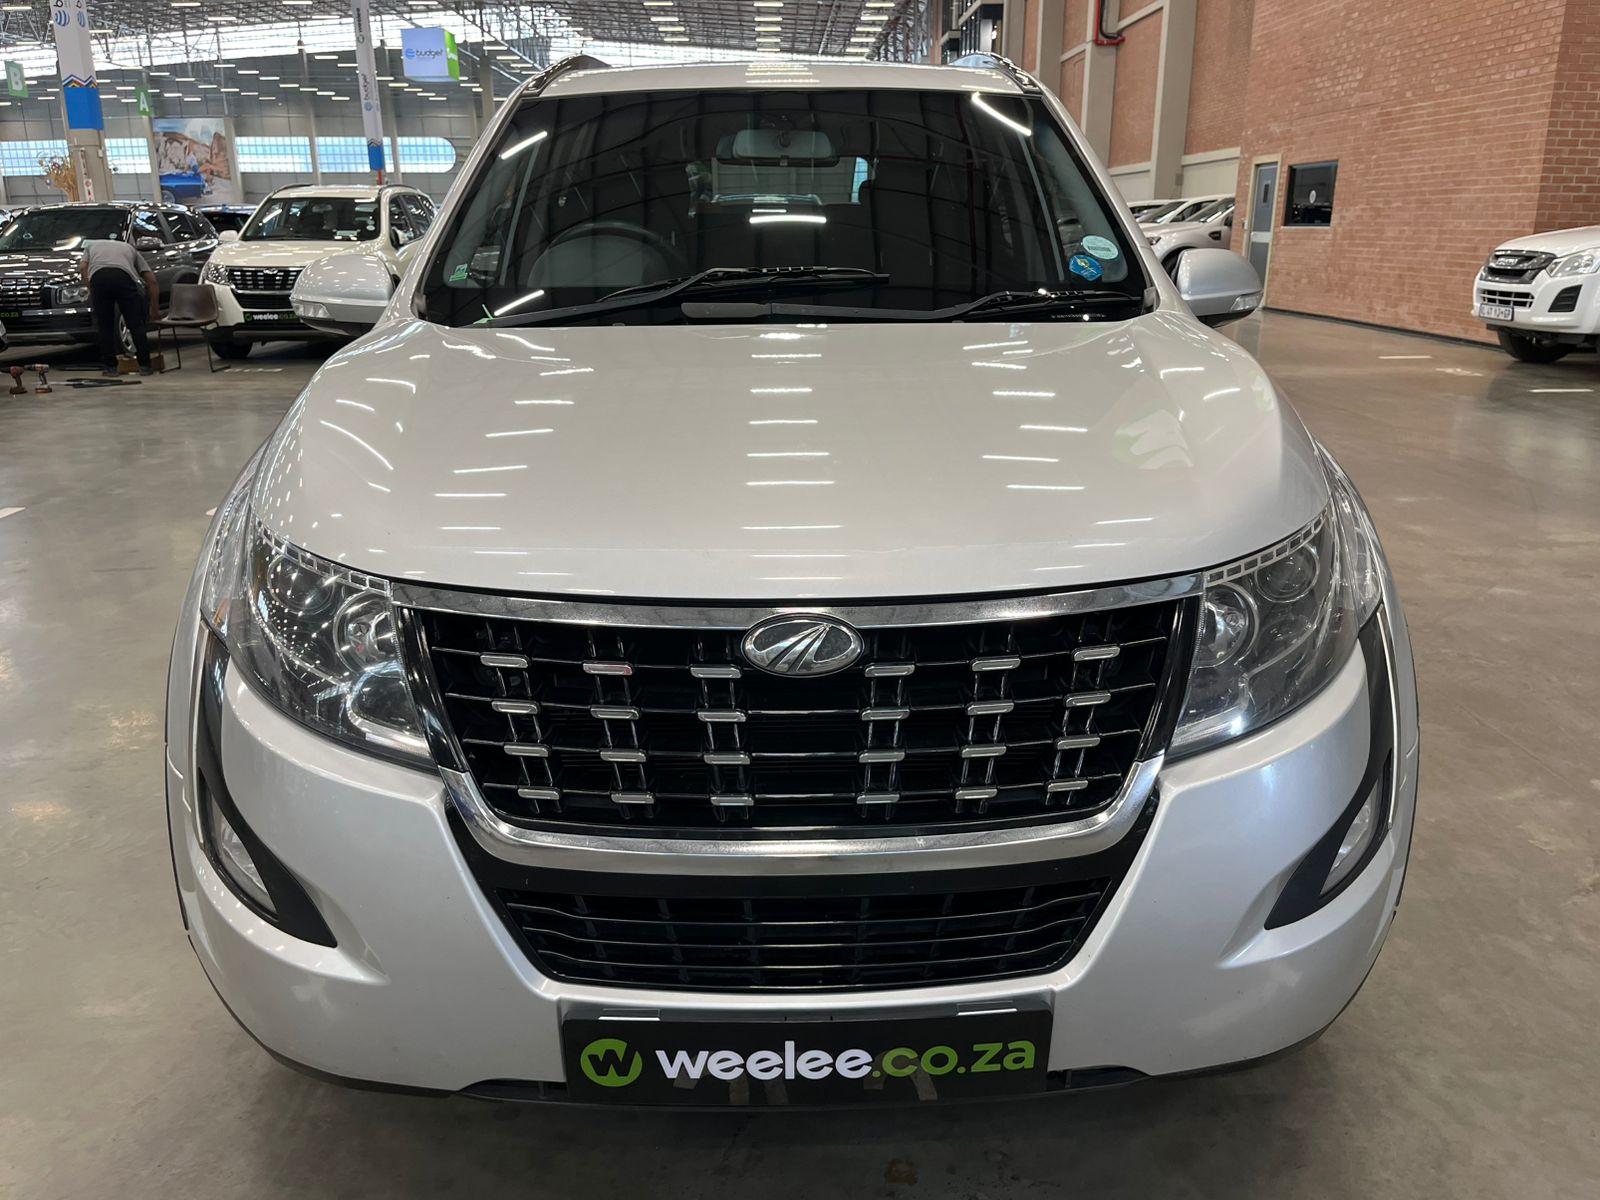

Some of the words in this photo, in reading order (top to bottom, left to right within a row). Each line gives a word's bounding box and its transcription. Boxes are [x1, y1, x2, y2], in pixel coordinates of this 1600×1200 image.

[10, 67, 23, 91] B
[140, 91, 149, 112] A
[655, 1040, 1036, 1081] weelee.co.za
